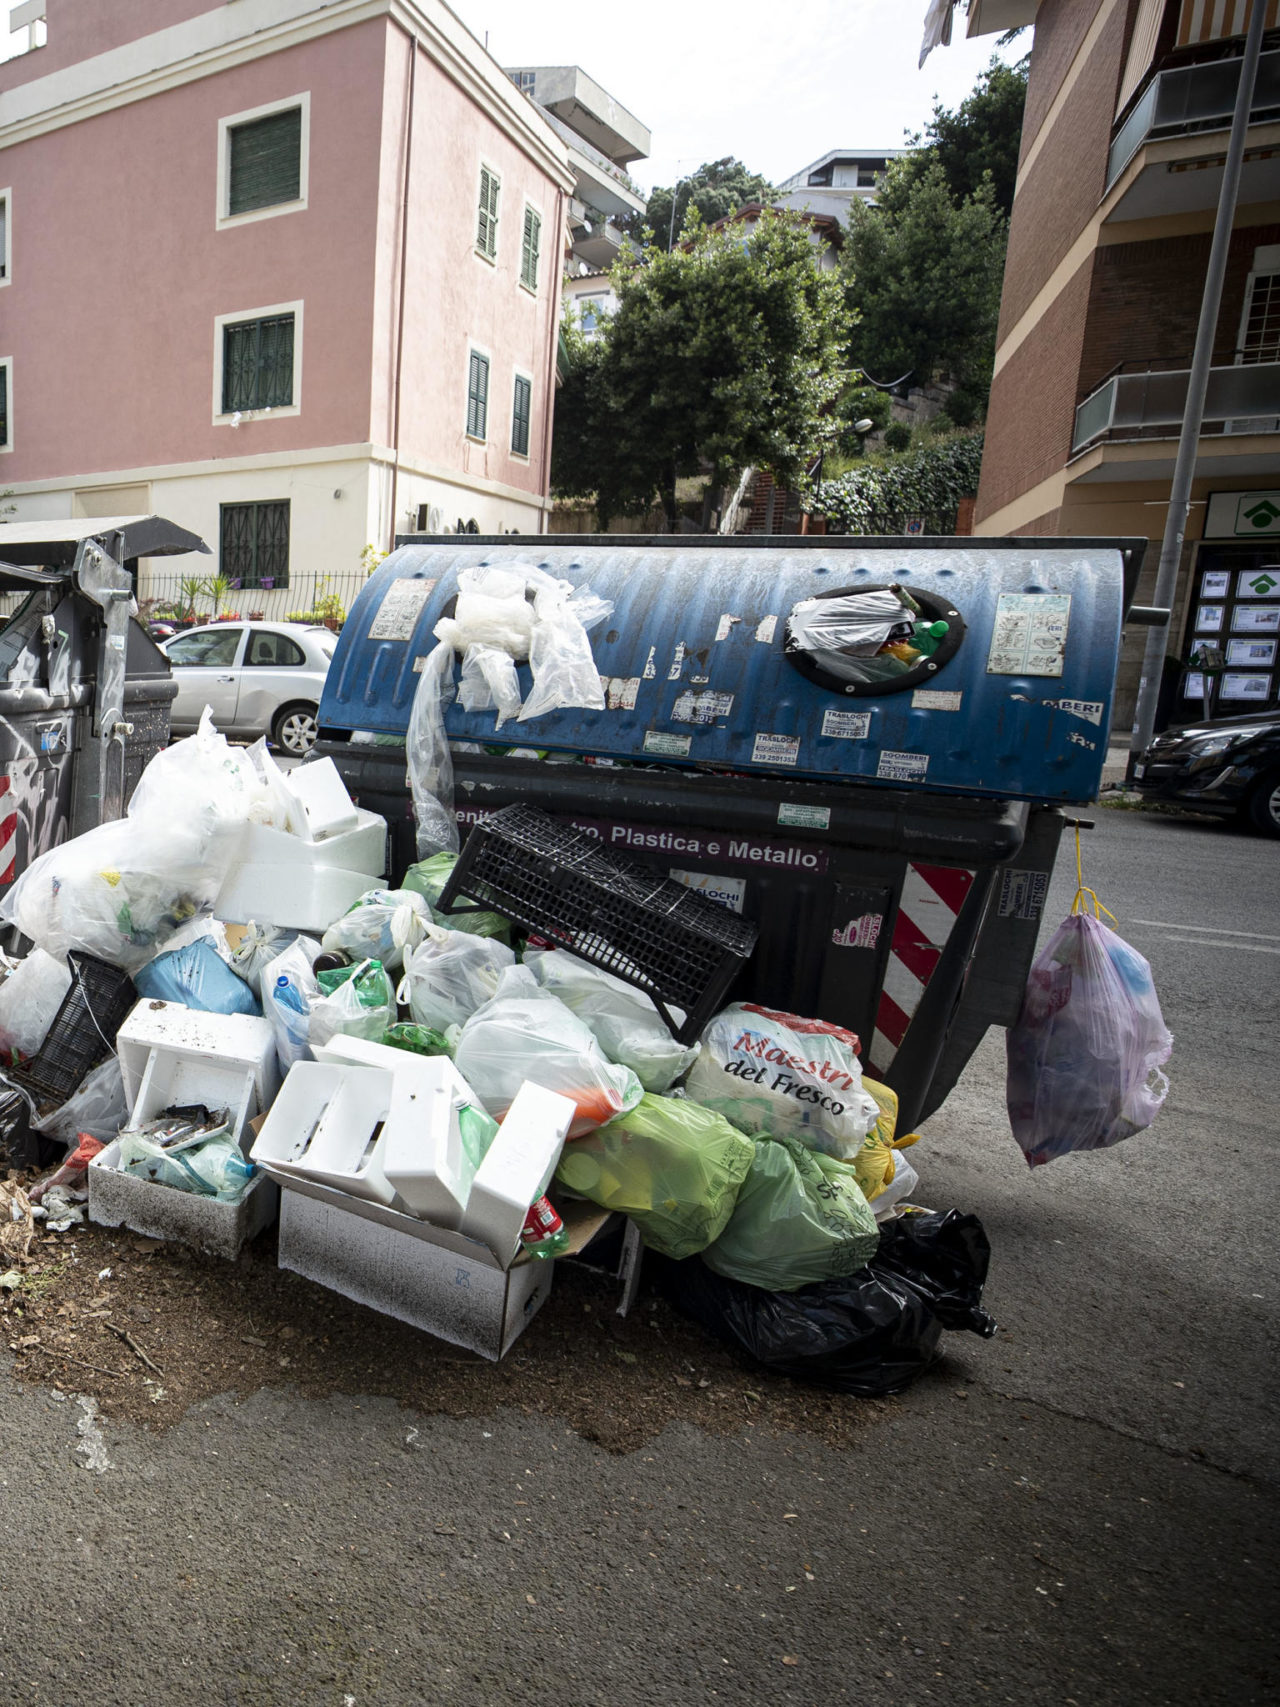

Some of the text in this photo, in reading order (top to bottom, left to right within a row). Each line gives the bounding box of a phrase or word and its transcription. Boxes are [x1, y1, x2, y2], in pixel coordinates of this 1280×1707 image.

[827, 711, 869, 720] TRASLOCHI
[758, 735, 799, 744] TRASLOCHI
[882, 751, 927, 761] SGOMBERI
[611, 826, 700, 854] Plastica
[706, 841, 720, 855] e
[728, 839, 818, 869] Metallo
[1031, 873, 1047, 904] 6715053
[733, 1032, 854, 1091] Maestri
[724, 1059, 845, 1116] del Fresco
